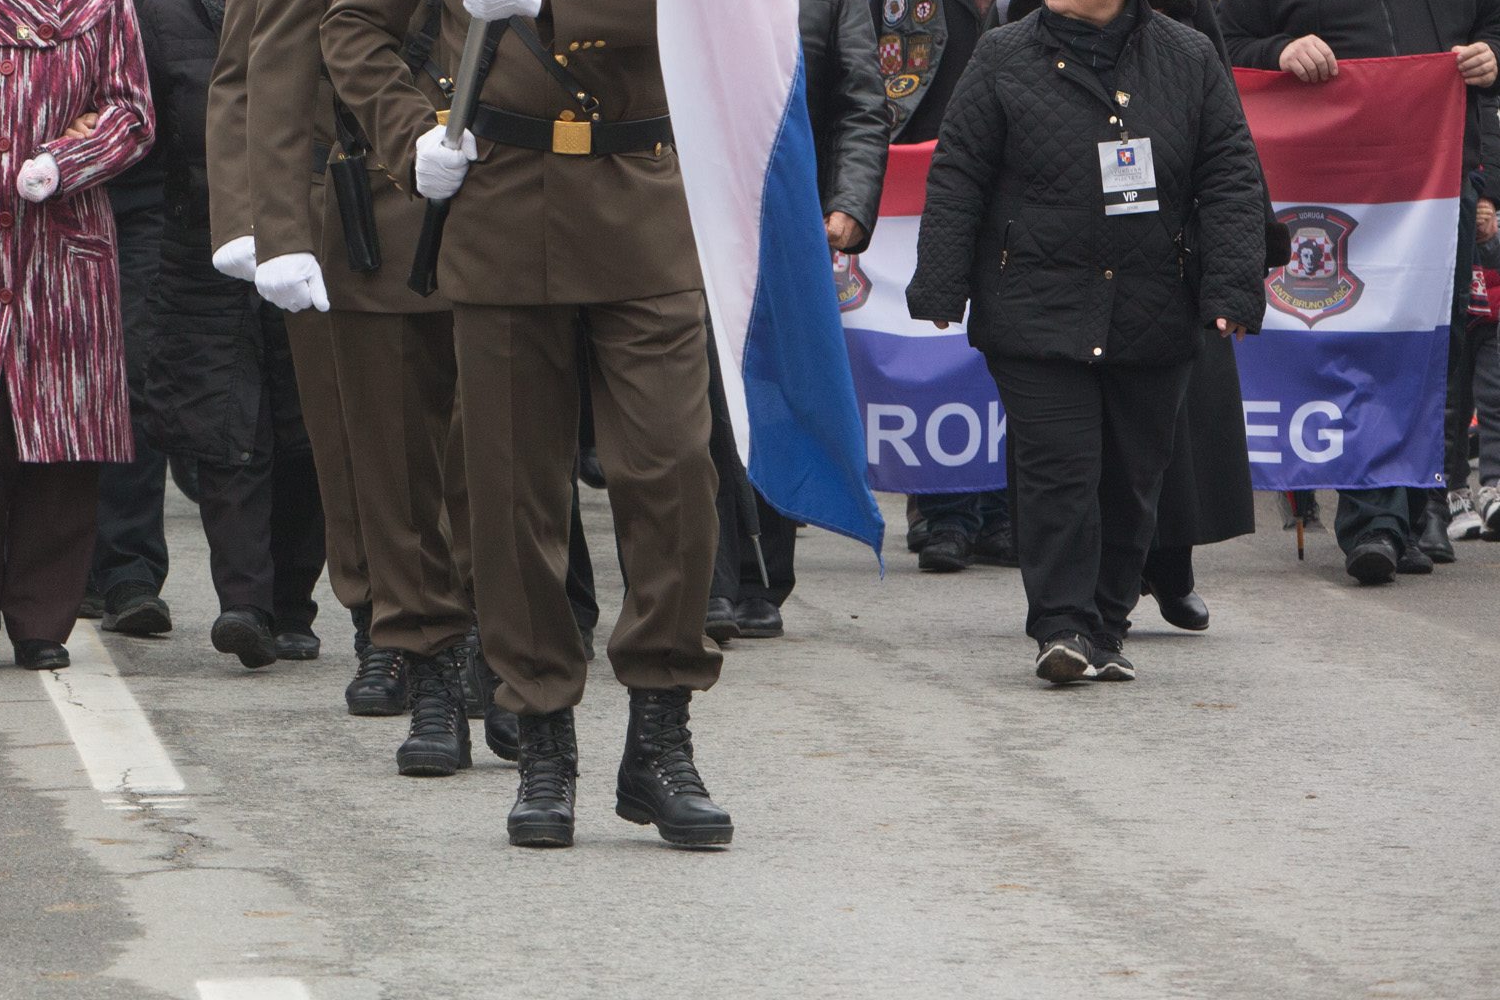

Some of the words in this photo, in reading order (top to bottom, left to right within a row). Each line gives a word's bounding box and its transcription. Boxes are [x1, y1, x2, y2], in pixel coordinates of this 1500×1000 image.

[1123, 191, 1138, 202] VIP
[1299, 211, 1325, 220] UDRUGA
[1272, 284, 1293, 304] ANTE
[1292, 298, 1325, 310] BRUNO
[1242, 400, 1344, 464] EG
